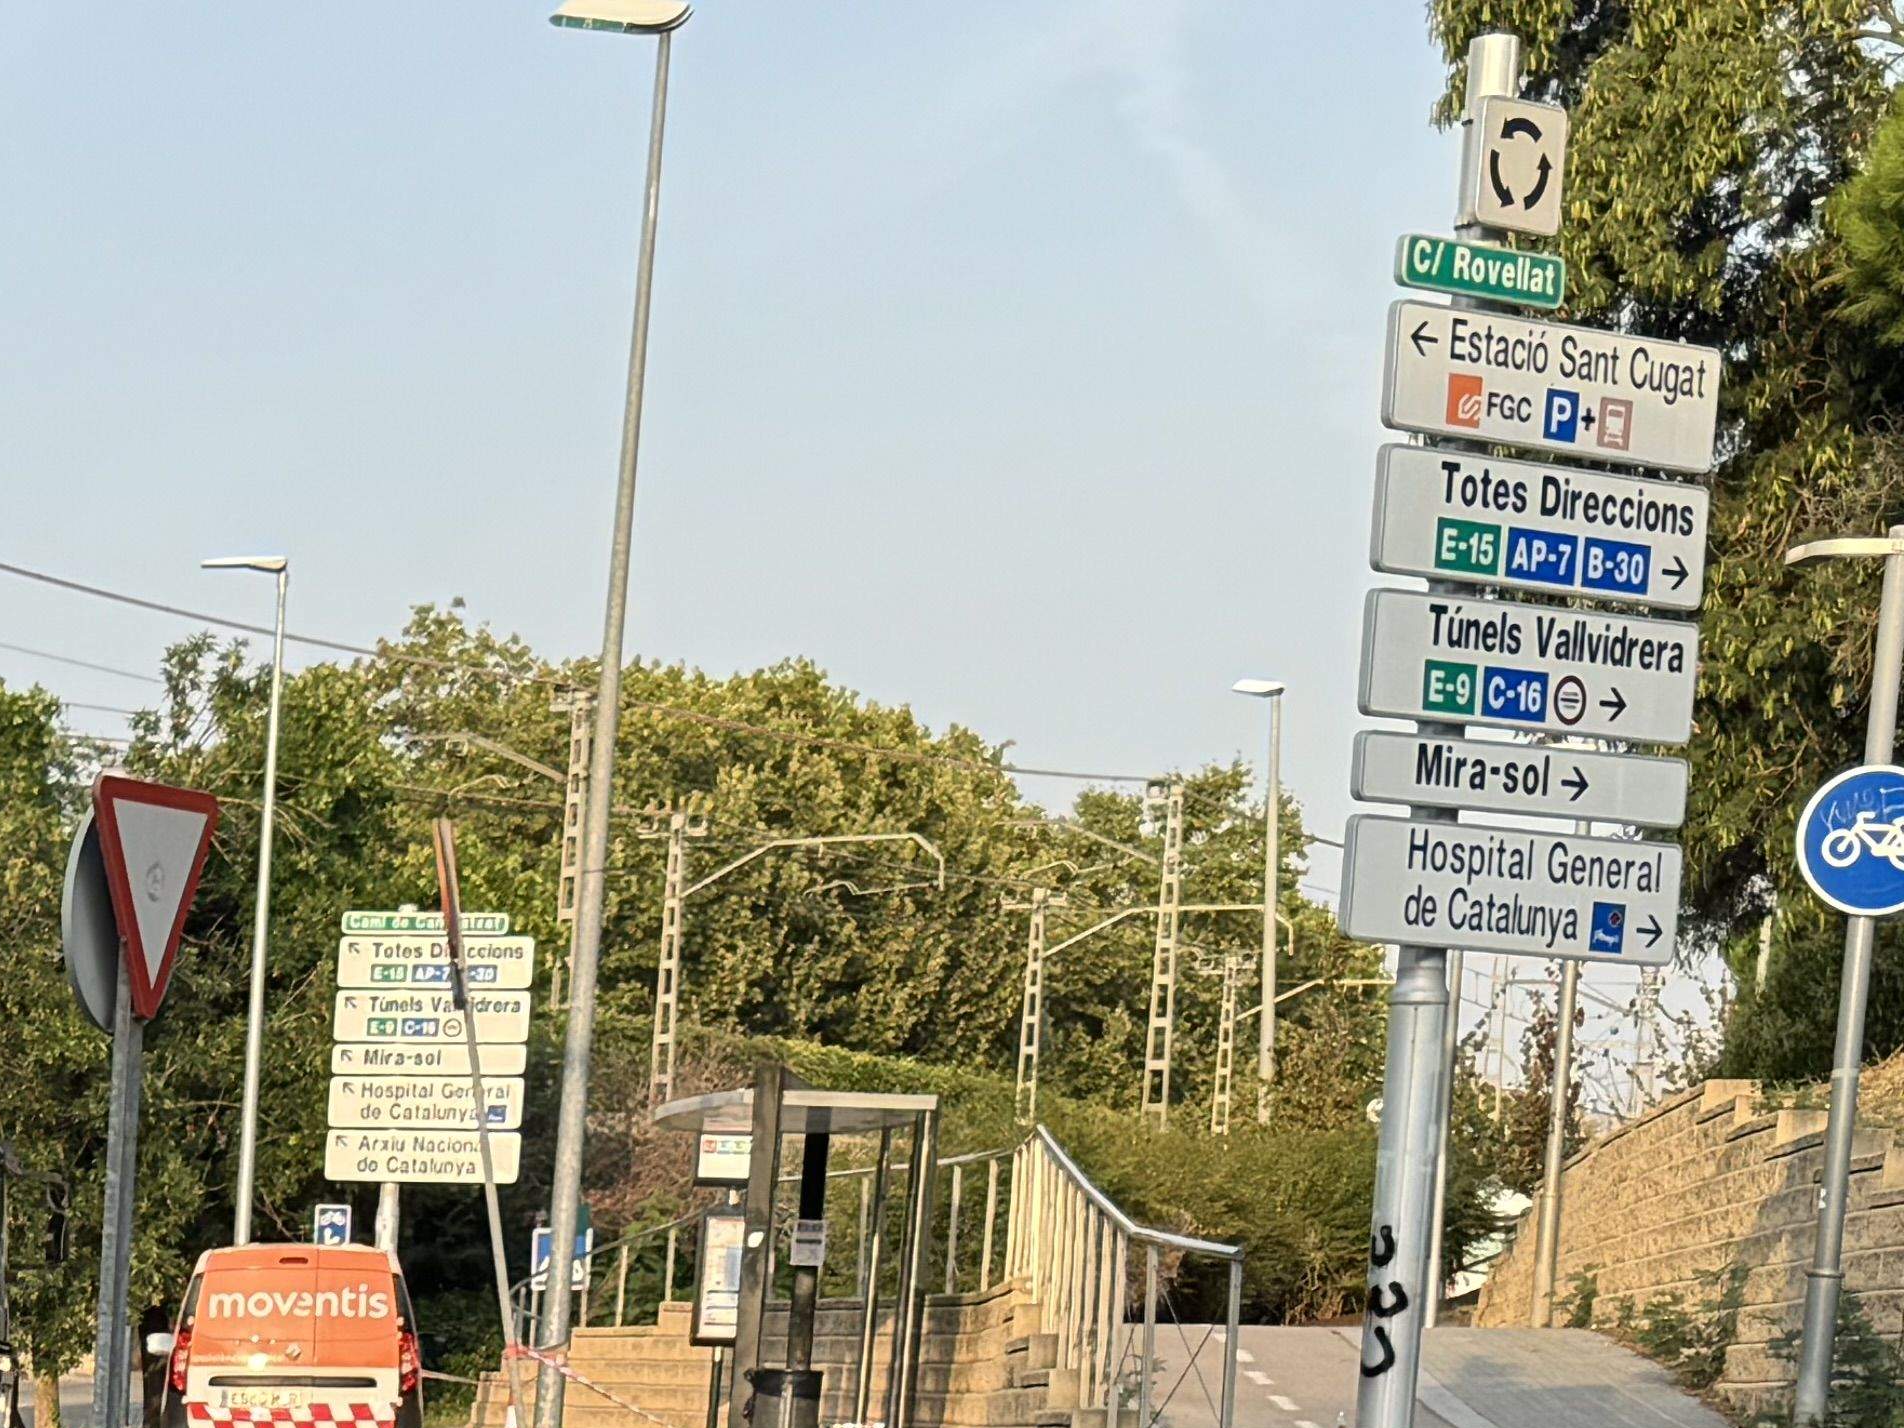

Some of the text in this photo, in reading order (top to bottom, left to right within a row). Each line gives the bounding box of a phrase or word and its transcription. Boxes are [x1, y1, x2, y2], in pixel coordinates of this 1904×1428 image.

[1412, 242, 1556, 296] C/ Rovellat
[1449, 318, 1706, 405] Estació Sant Cugat
[1486, 391, 1532, 422] FGC
[1440, 461, 1695, 536] Totes Direccions
[1441, 524, 1645, 587] E-15 AP-7 B-30
[1428, 604, 1684, 674] Túnels Vallvidrera
[1429, 668, 1542, 714] E-9 C-16
[1416, 743, 1550, 796] Mira-sol
[1408, 828, 1661, 893] Hospital General
[1404, 884, 1579, 948] de Catalunya
[372, 942, 423, 959] Totes
[368, 995, 423, 1013] Túnels
[363, 1049, 442, 1066] Mira-sol
[360, 1083, 433, 1100] Hospital
[360, 1103, 382, 1120] de
[358, 1135, 405, 1152] Arxiu
[357, 1156, 476, 1176] de Catalunya
[208, 1283, 390, 1320] moventis
